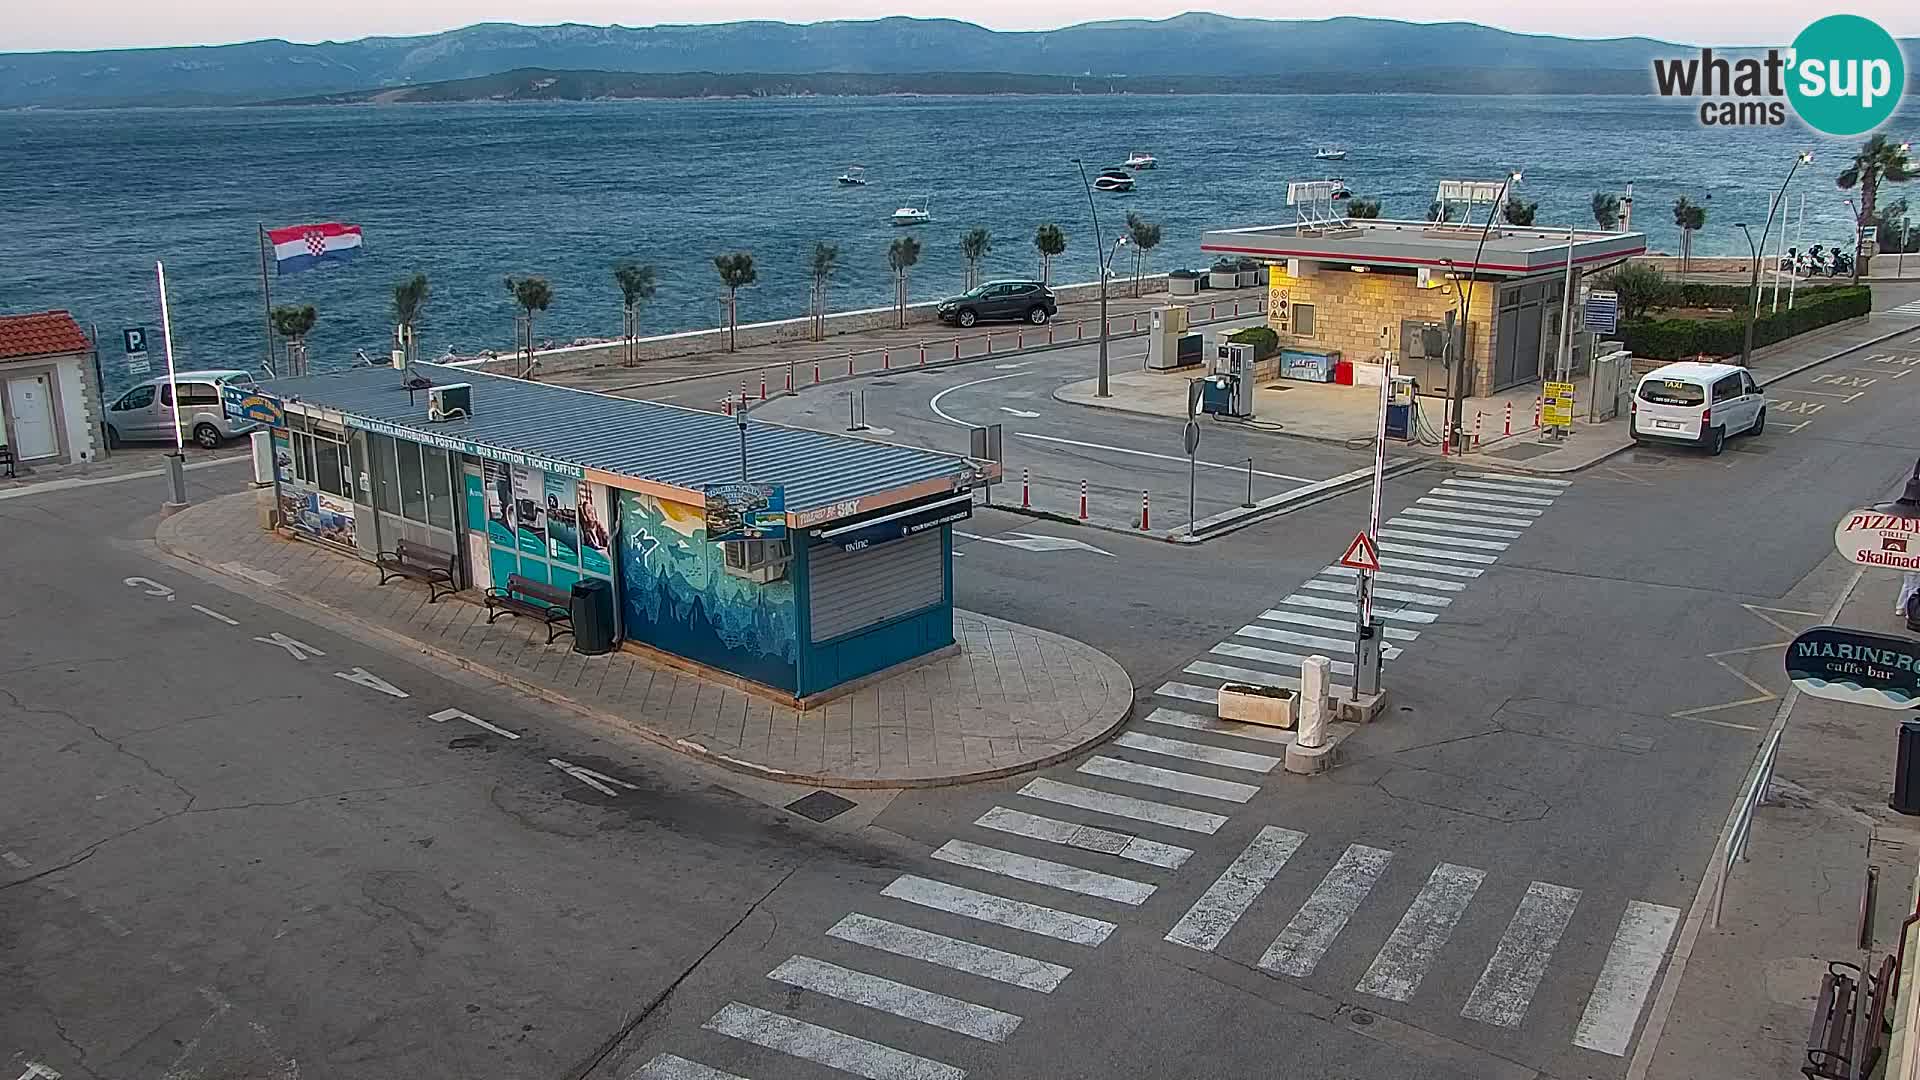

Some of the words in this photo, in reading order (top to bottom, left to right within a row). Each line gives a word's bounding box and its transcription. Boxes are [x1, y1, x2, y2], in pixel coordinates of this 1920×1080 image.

[128, 331, 141, 350] P
[1664, 381, 1683, 389] TAXI
[1811, 374, 1878, 388] TAXI
[435, 435, 466, 452] POSTAJA
[476, 445, 493, 457] BUS
[492, 449, 525, 465] STATION
[527, 456, 553, 471] TICKET
[554, 463, 581, 477] OFFICE
[836, 499, 861, 518] SKY
[1846, 515, 1920, 535] PIZZE
[1856, 549, 1920, 569] Skalinad
[1826, 661, 1863, 677] caffe
[1867, 665, 1895, 680] bar
